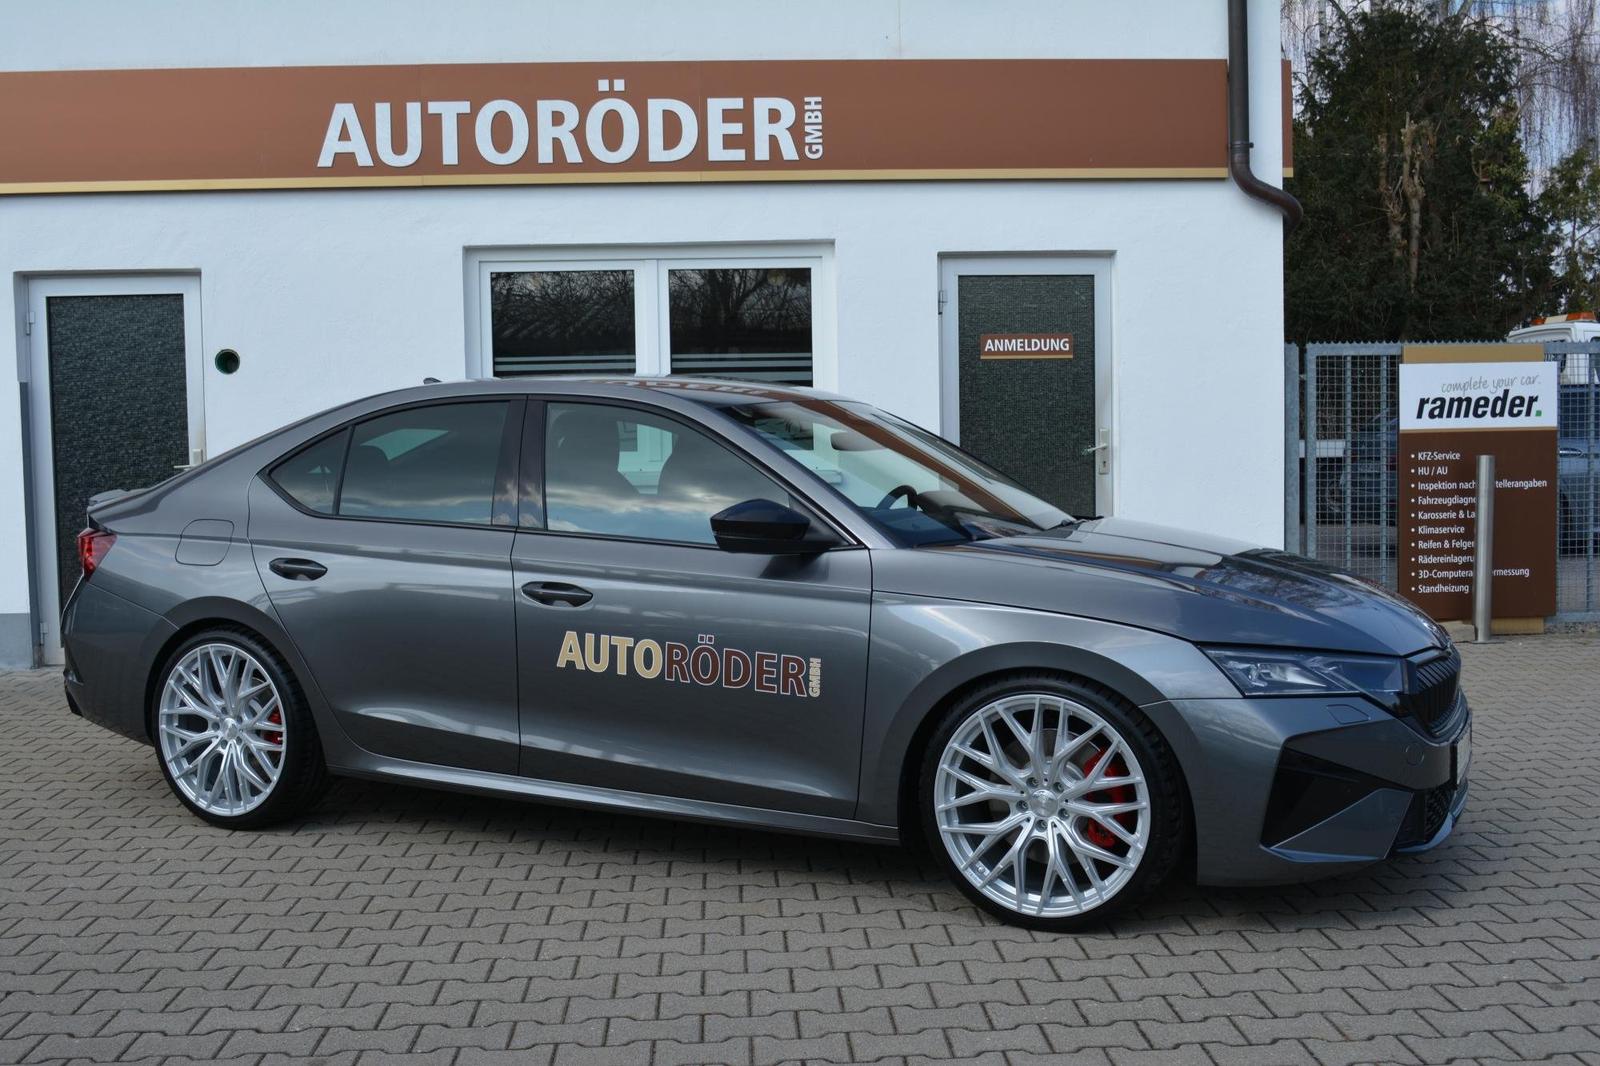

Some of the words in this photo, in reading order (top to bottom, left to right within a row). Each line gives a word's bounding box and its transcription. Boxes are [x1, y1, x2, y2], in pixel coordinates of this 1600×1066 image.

[316, 78, 800, 168] AUTORÖDER
[804, 96, 823, 160] GMBH
[984, 338, 1070, 351] ANMELDUNG
[1441, 376, 1489, 396] complete
[1490, 376, 1517, 394] your
[1520, 374, 1541, 386] car.
[1418, 452, 1461, 461] KFZ-Service
[1418, 467, 1430, 476] HU
[1437, 466, 1448, 475] AU
[1418, 480, 1457, 492] Inspektion
[1495, 478, 1547, 490] tellerangaben
[1418, 495, 1477, 506] Fahrzeugdiagno
[1418, 510, 1457, 519] Karosserie
[1458, 510, 1465, 519] &
[1466, 510, 1476, 518] La
[1418, 525, 1465, 534] Klimaservice
[1418, 540, 1442, 549] Reifen
[1443, 540, 1450, 548] &
[1418, 554, 1474, 565] Rädereinlageru
[1418, 584, 1469, 594] Standheizung
[556, 630, 807, 698] AUTORÖDER
[809, 657, 821, 698] GMBH
